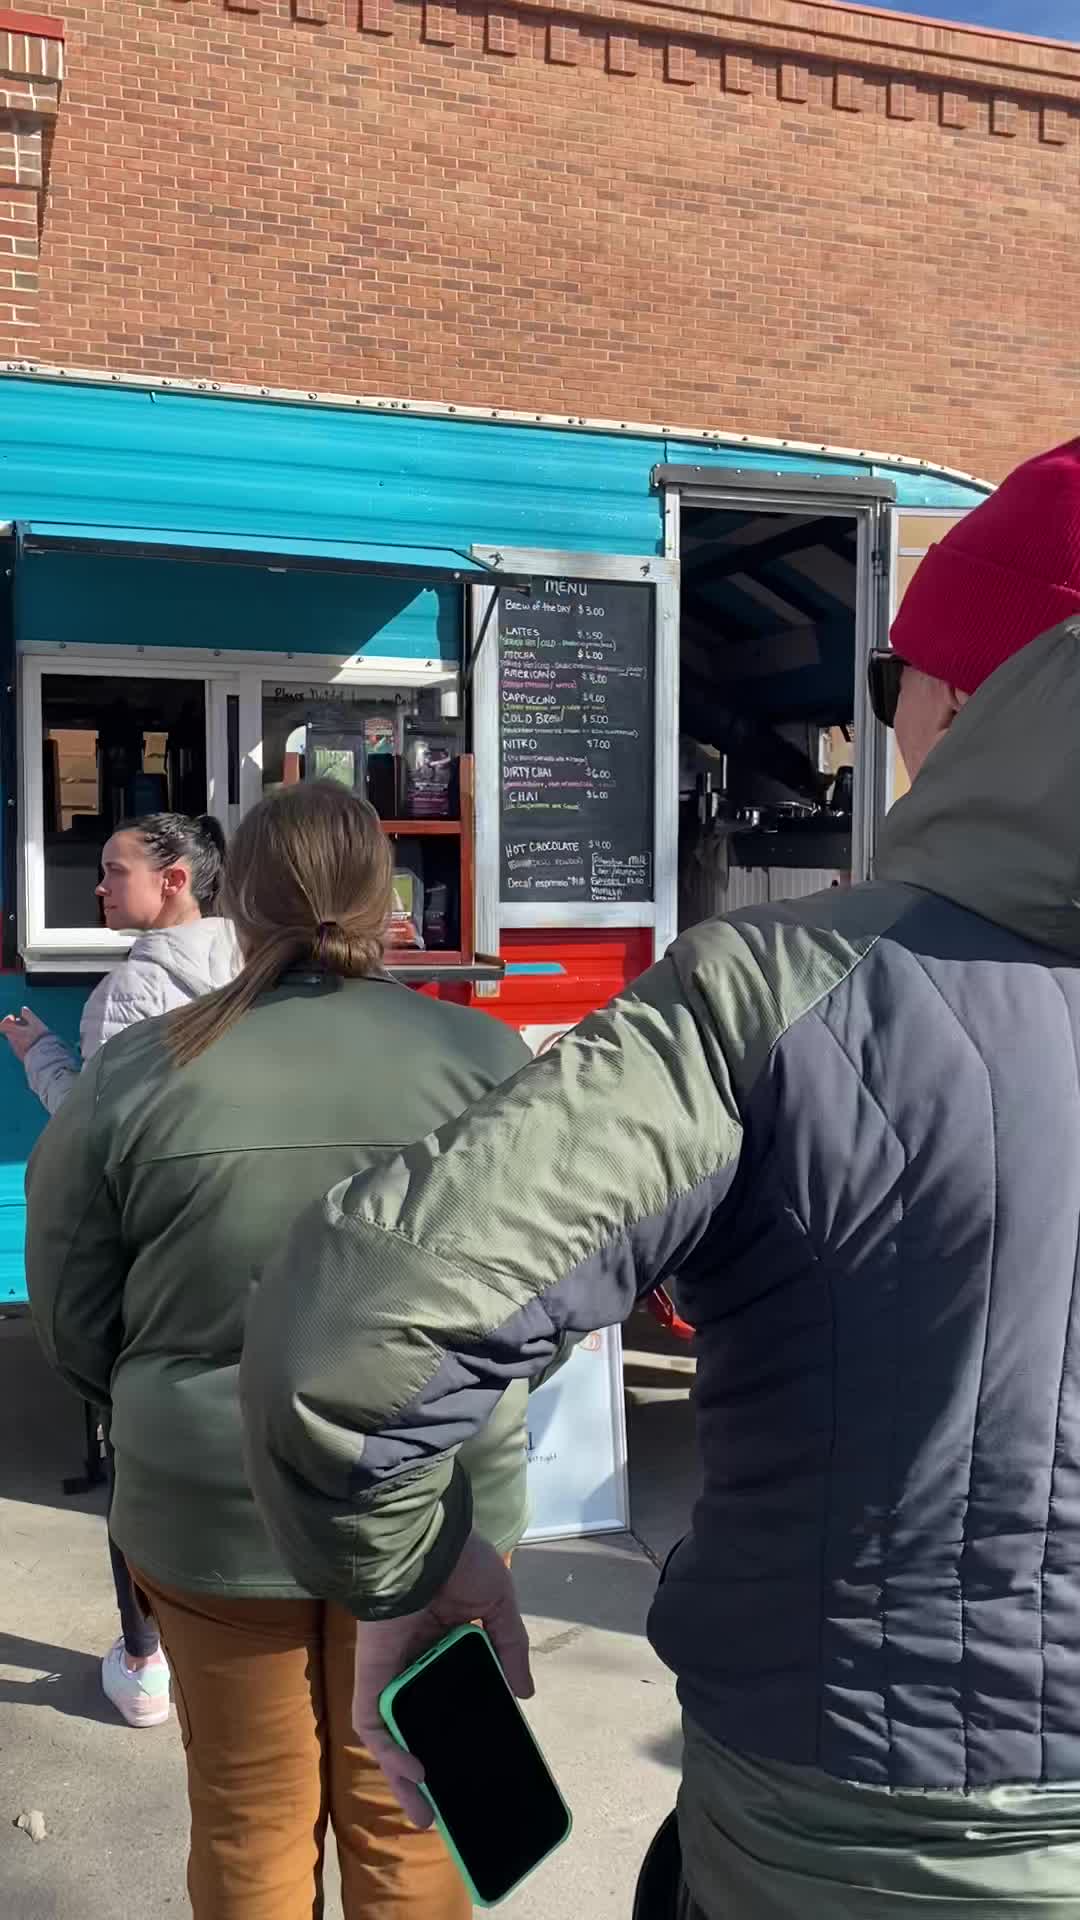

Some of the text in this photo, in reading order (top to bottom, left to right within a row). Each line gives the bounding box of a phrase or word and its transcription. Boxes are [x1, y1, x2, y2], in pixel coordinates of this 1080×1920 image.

[545, 580, 588, 597] MENU
[505, 627, 540, 636] LATTES
[503, 667, 557, 680] AMERICANO
[502, 690, 557, 704] CAPPUCCINO
[502, 712, 533, 725] COLD
[503, 738, 538, 750] NITRO
[503, 766, 530, 779] DIRTY
[508, 791, 539, 802] CHAI
[505, 844, 527, 858] HOT
[529, 841, 580, 852] CHOCOLATE
